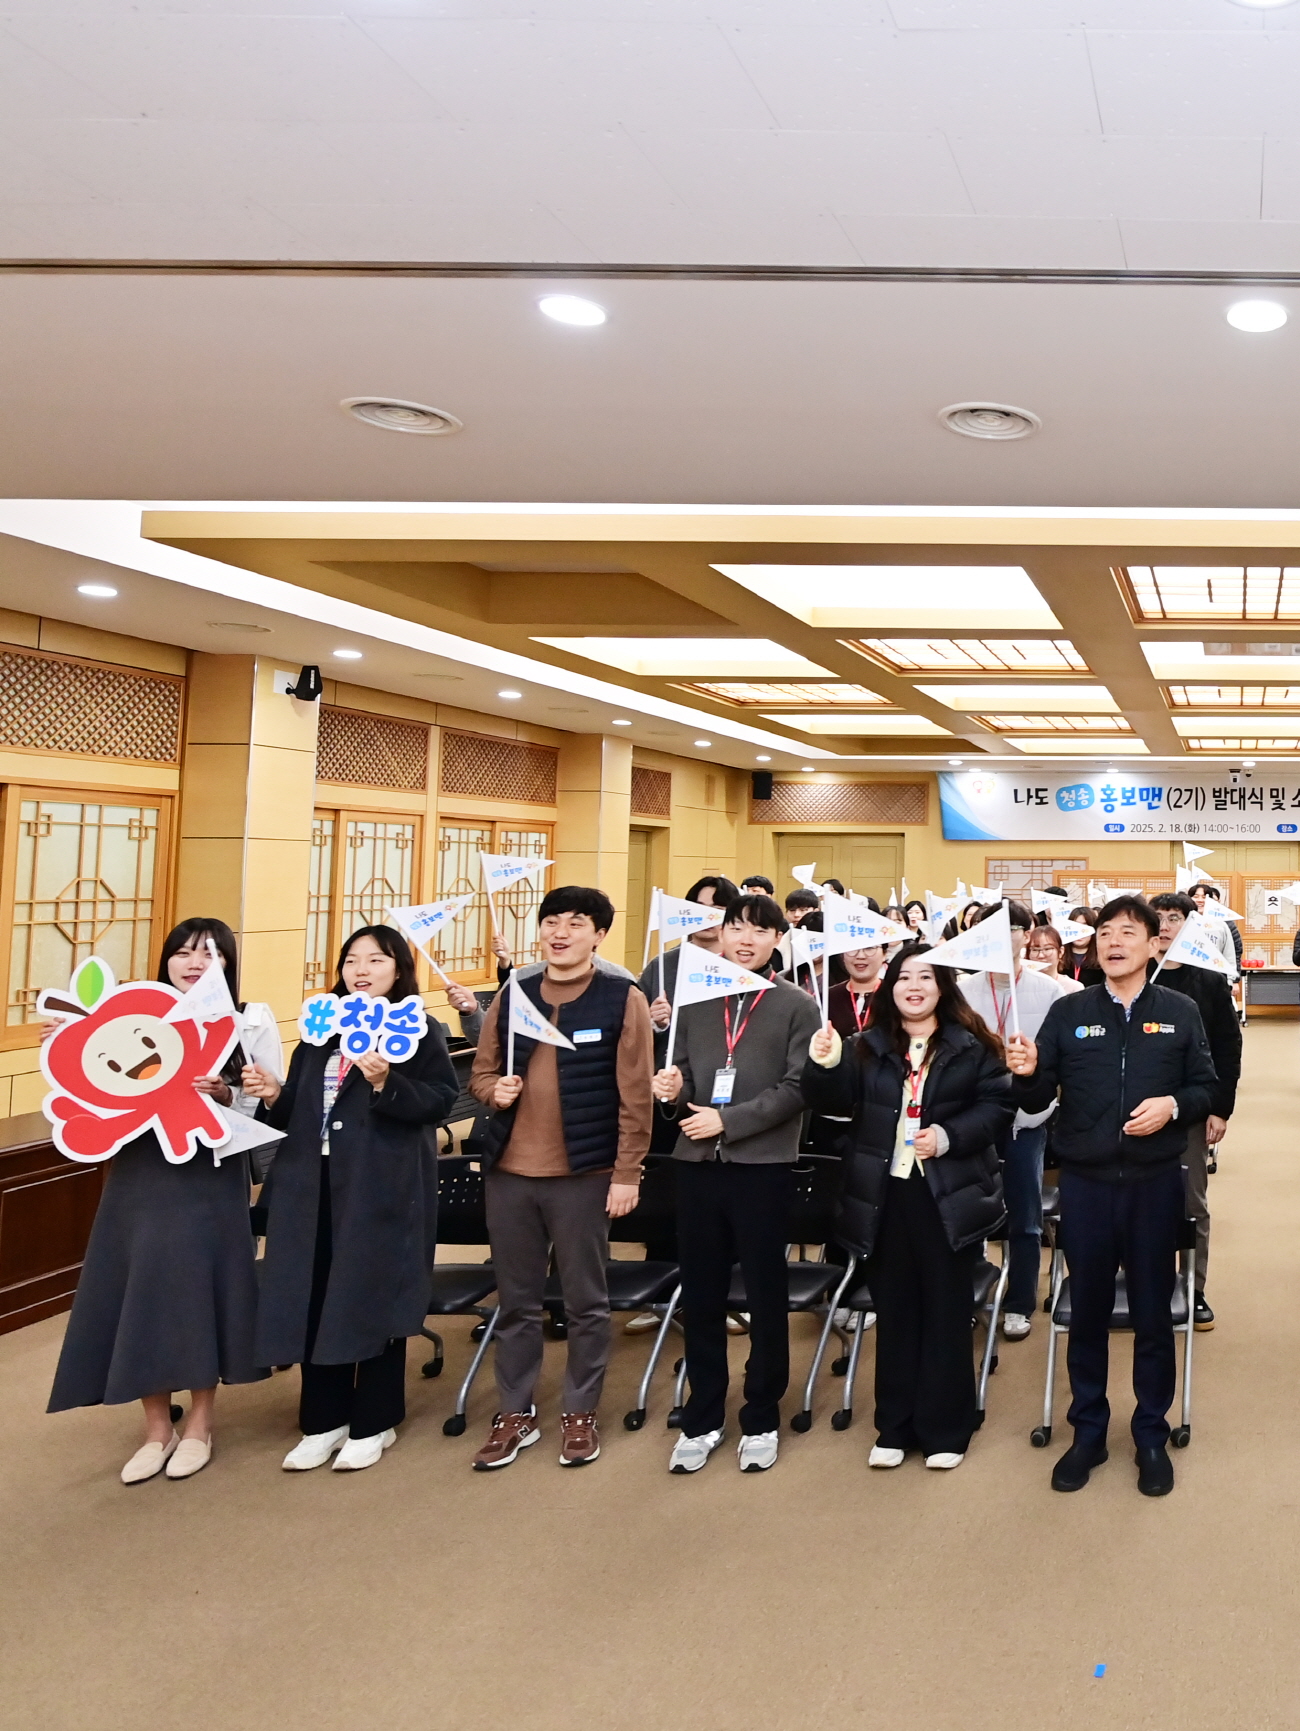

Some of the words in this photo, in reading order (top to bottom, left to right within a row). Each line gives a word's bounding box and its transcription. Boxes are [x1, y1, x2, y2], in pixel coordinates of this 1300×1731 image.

[1013, 787, 1049, 806] 나도
[1060, 788, 1090, 808] 청송
[1100, 784, 1163, 813] 홍보맨
[1166, 787, 1206, 811] (2기)
[1213, 787, 1264, 811] 발대식
[1270, 787, 1286, 811] 및
[1130, 824, 1156, 833] 2025.
[1158, 824, 1167, 833] 2.
[1203, 824, 1261, 834] 14:00~16:00
[304, 997, 420, 1056] #청송
